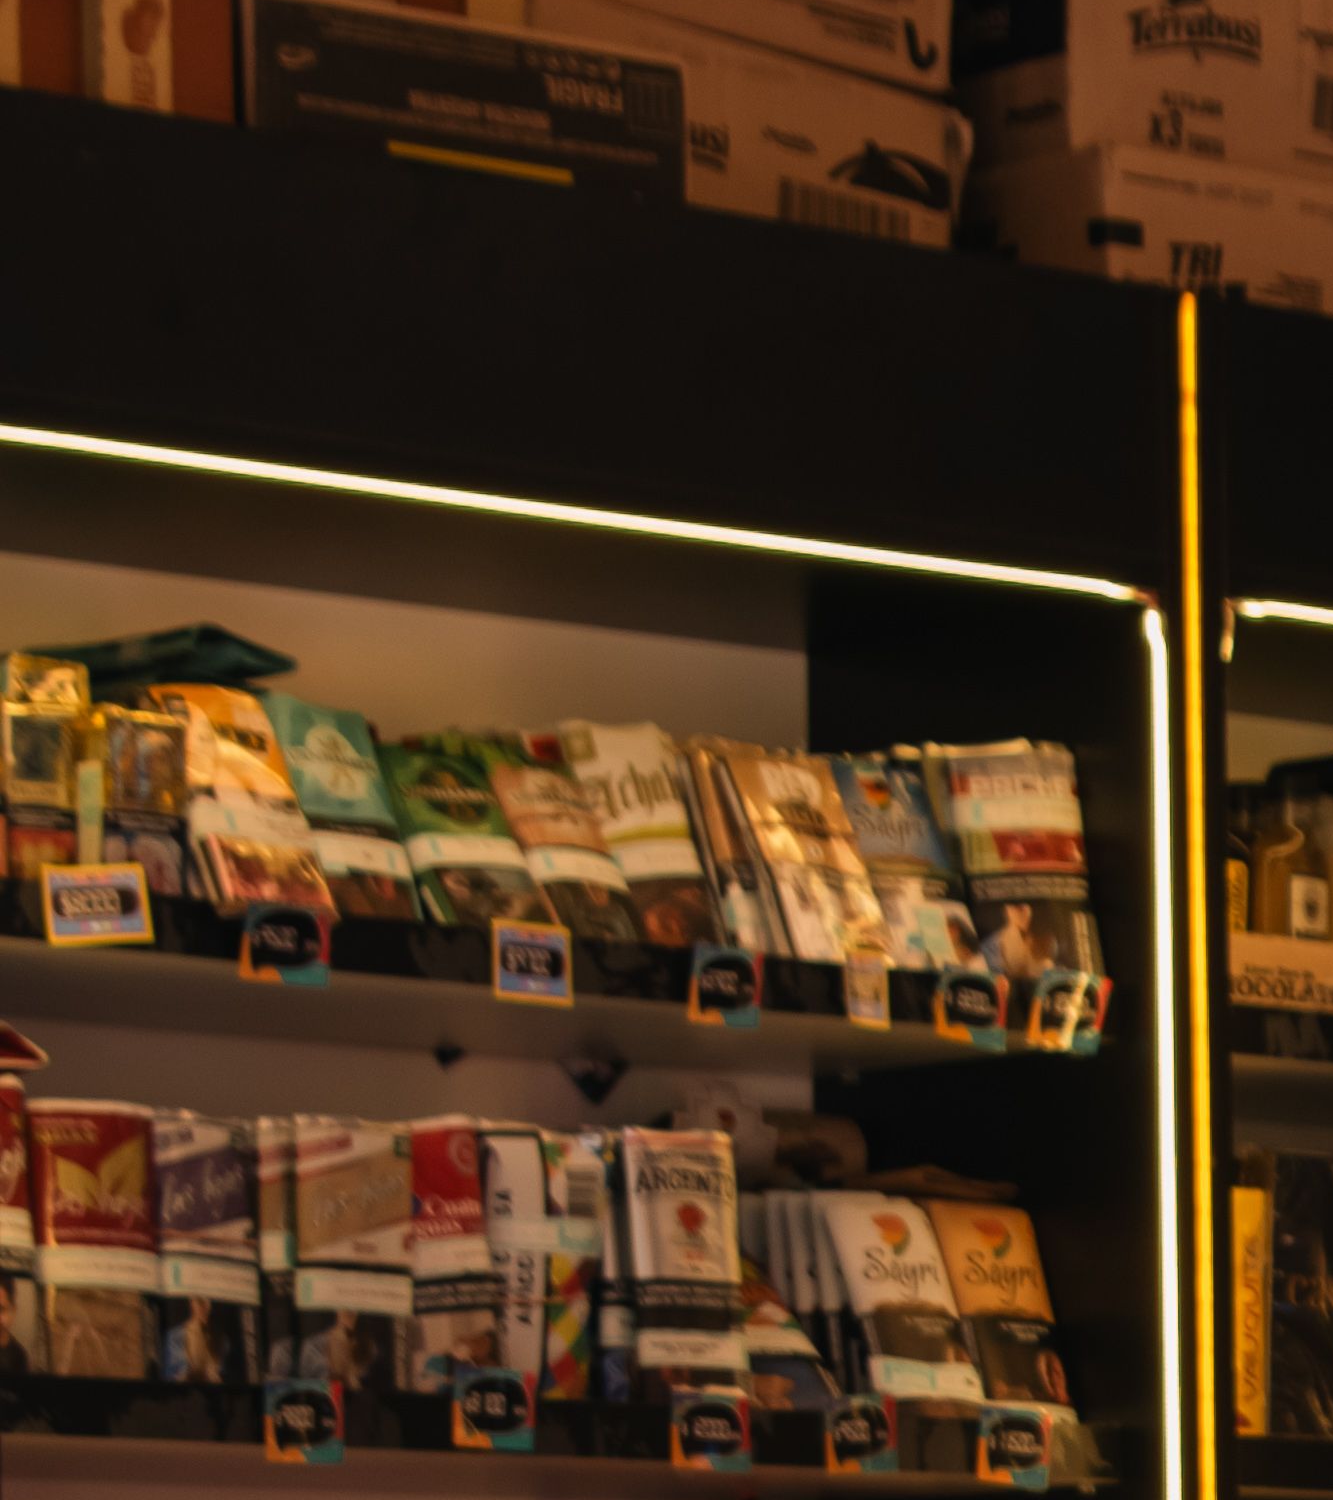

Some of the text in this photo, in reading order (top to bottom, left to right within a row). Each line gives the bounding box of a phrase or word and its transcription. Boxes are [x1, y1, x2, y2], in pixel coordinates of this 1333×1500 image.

[1127, 5, 1263, 65] Terrabusi
[862, 1246, 942, 1297] Sayri
[963, 1248, 1041, 1300] Sayri
